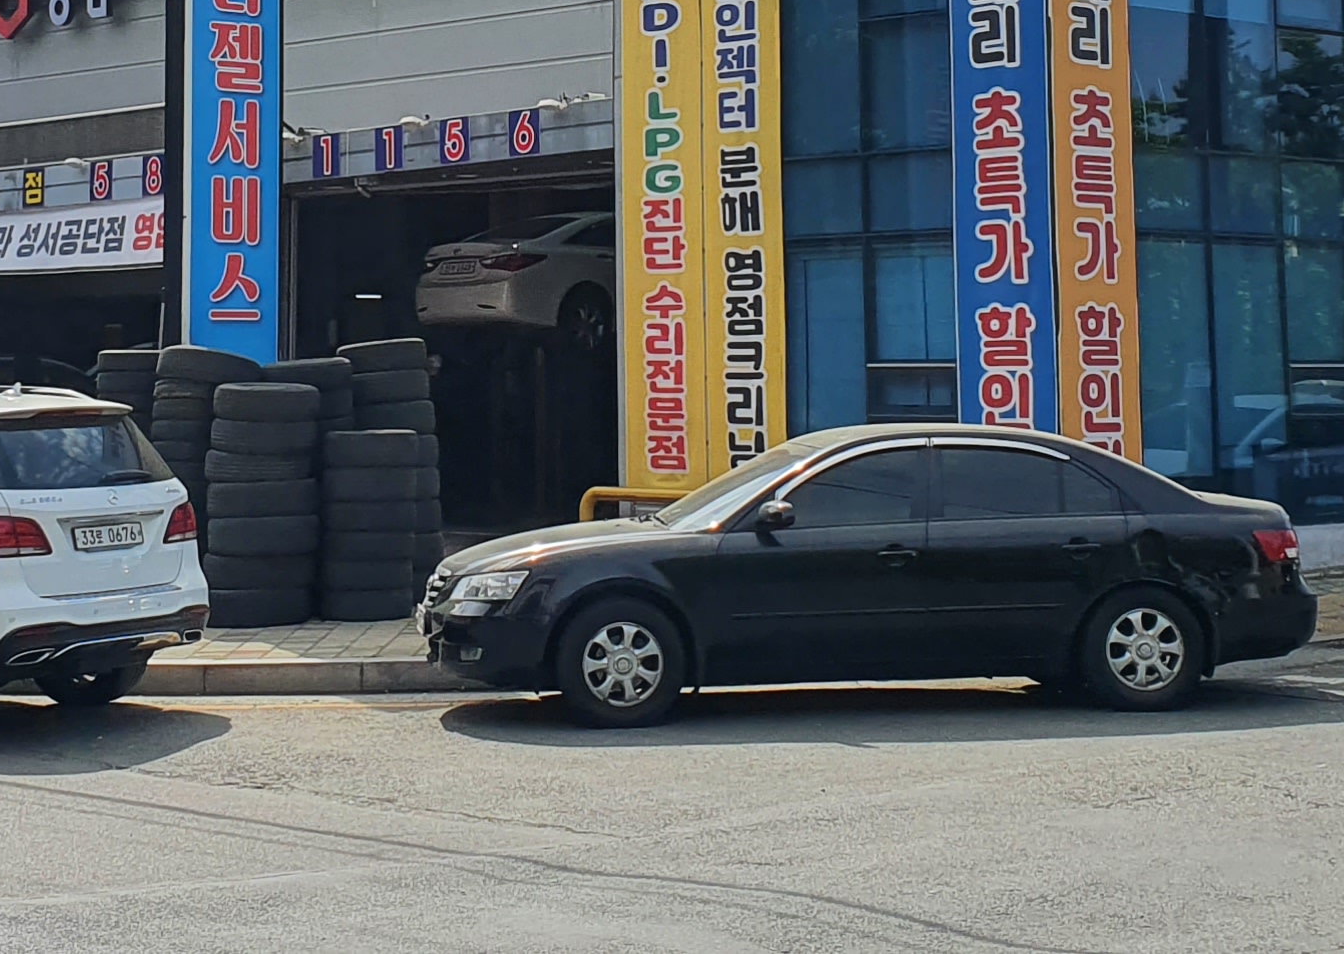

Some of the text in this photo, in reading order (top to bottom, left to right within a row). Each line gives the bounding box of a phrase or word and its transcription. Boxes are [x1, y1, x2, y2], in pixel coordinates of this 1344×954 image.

[16, 214, 127, 258] 성서공단점
[720, 146, 762, 233] 분해
[973, 89, 1031, 280] 초특가
[1071, 88, 1120, 281] 초특가
[644, 284, 688, 471] 수리전문점
[108, 525, 138, 544] 0676
